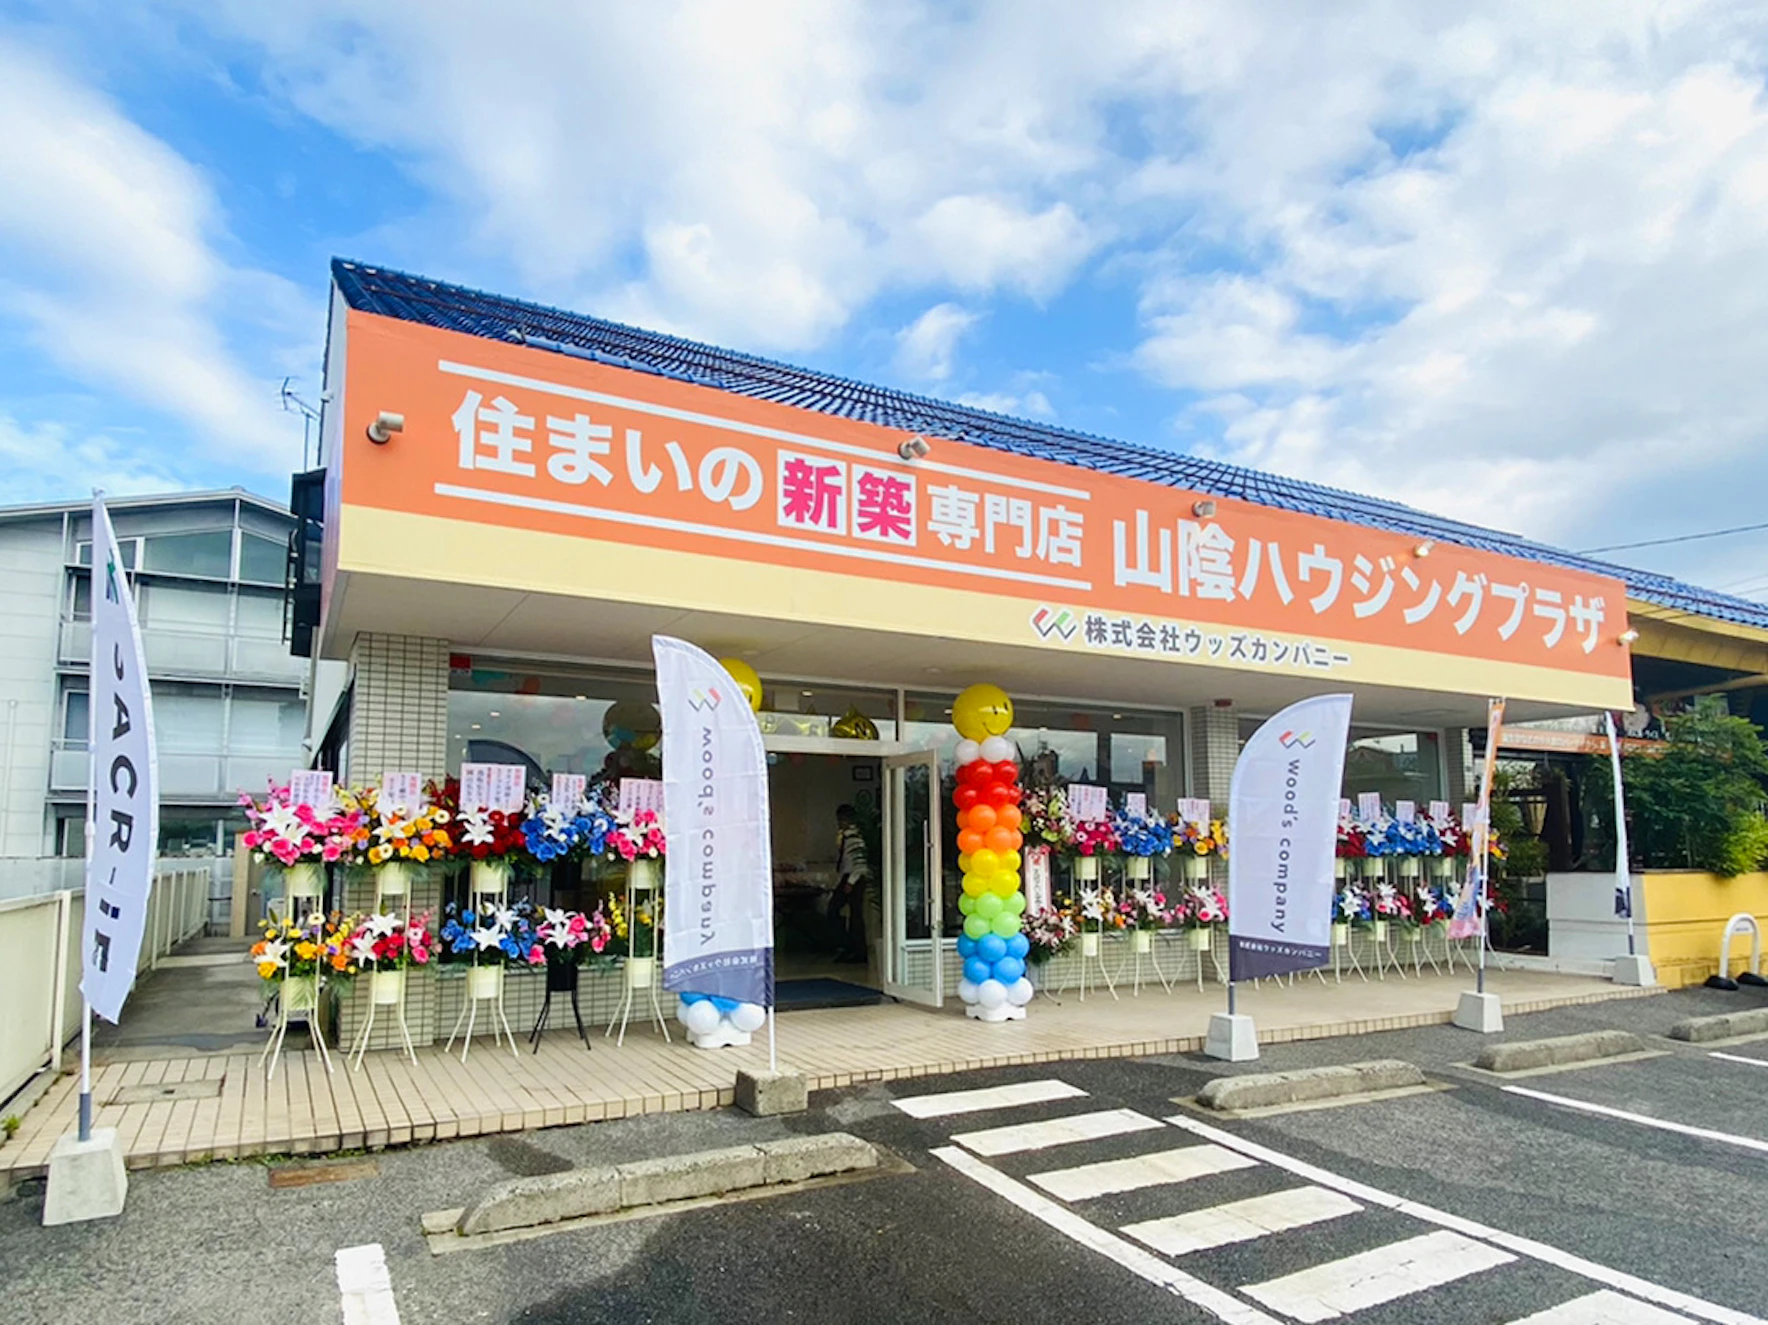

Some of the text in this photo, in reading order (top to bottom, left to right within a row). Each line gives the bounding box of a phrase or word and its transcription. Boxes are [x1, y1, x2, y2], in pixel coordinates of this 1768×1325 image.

[451, 389, 1606, 654] 住まいの新築専門店 山陰ハウジングプラザ
[1084, 615, 1349, 667] 株式会社ウッズカンパニー
[1270, 759, 1300, 934] wood's company
